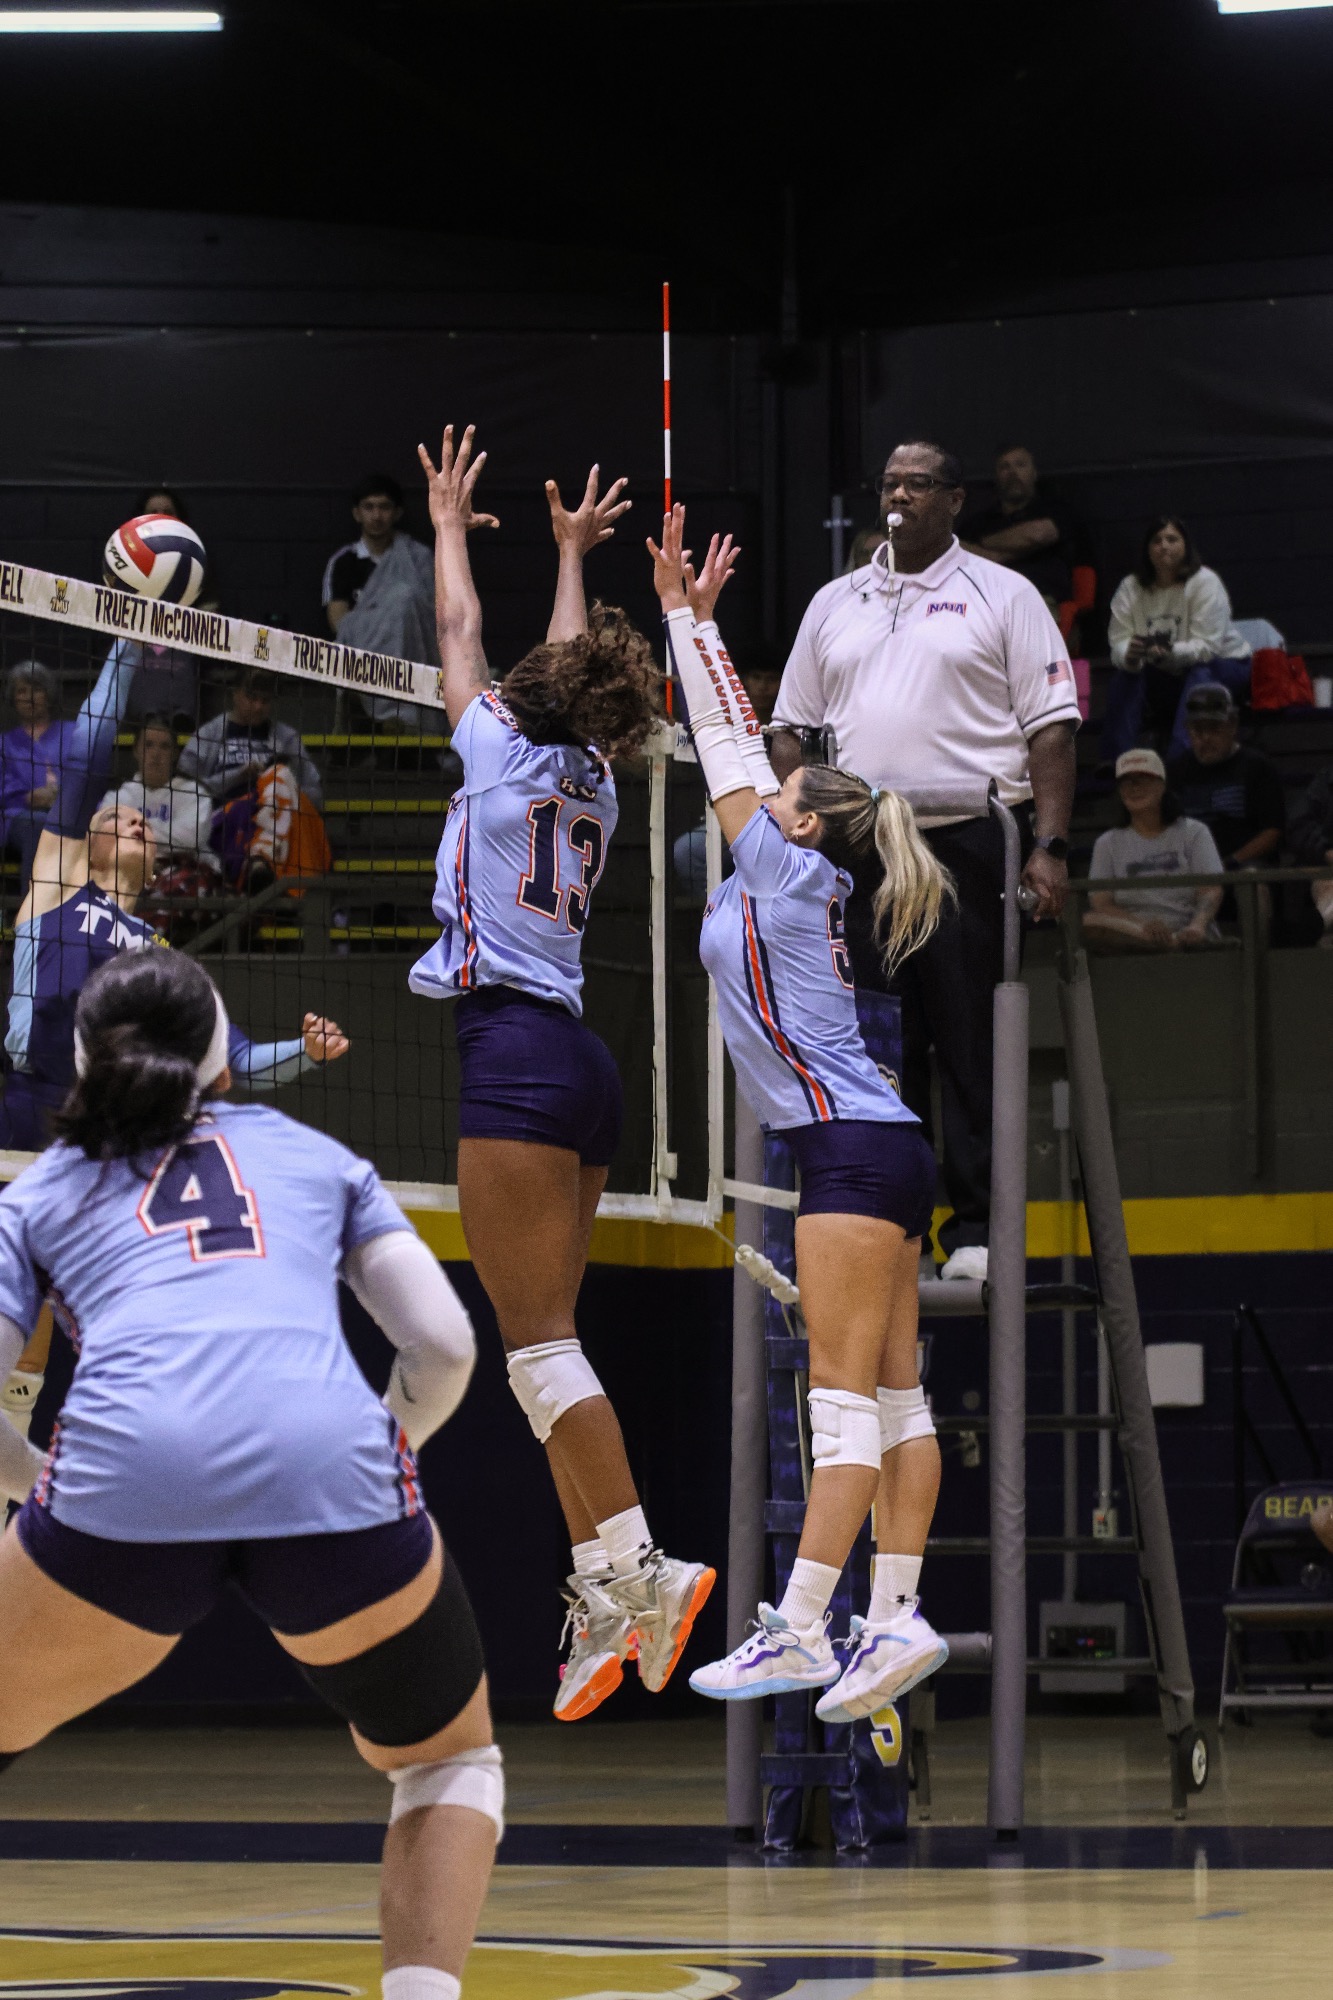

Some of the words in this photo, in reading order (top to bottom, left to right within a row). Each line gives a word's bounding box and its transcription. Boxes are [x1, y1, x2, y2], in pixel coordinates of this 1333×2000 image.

[0, 563, 24, 604] ELL
[927, 602, 967, 617] NAIA
[95, 587, 148, 633] TRUETT
[150, 601, 231, 653] McCONNELL
[293, 635, 341, 678] TRUETT
[343, 647, 415, 694] McCONNELL
[515, 794, 605, 934] 13
[74, 901, 152, 953] TM
[135, 1133, 267, 1264] 4
